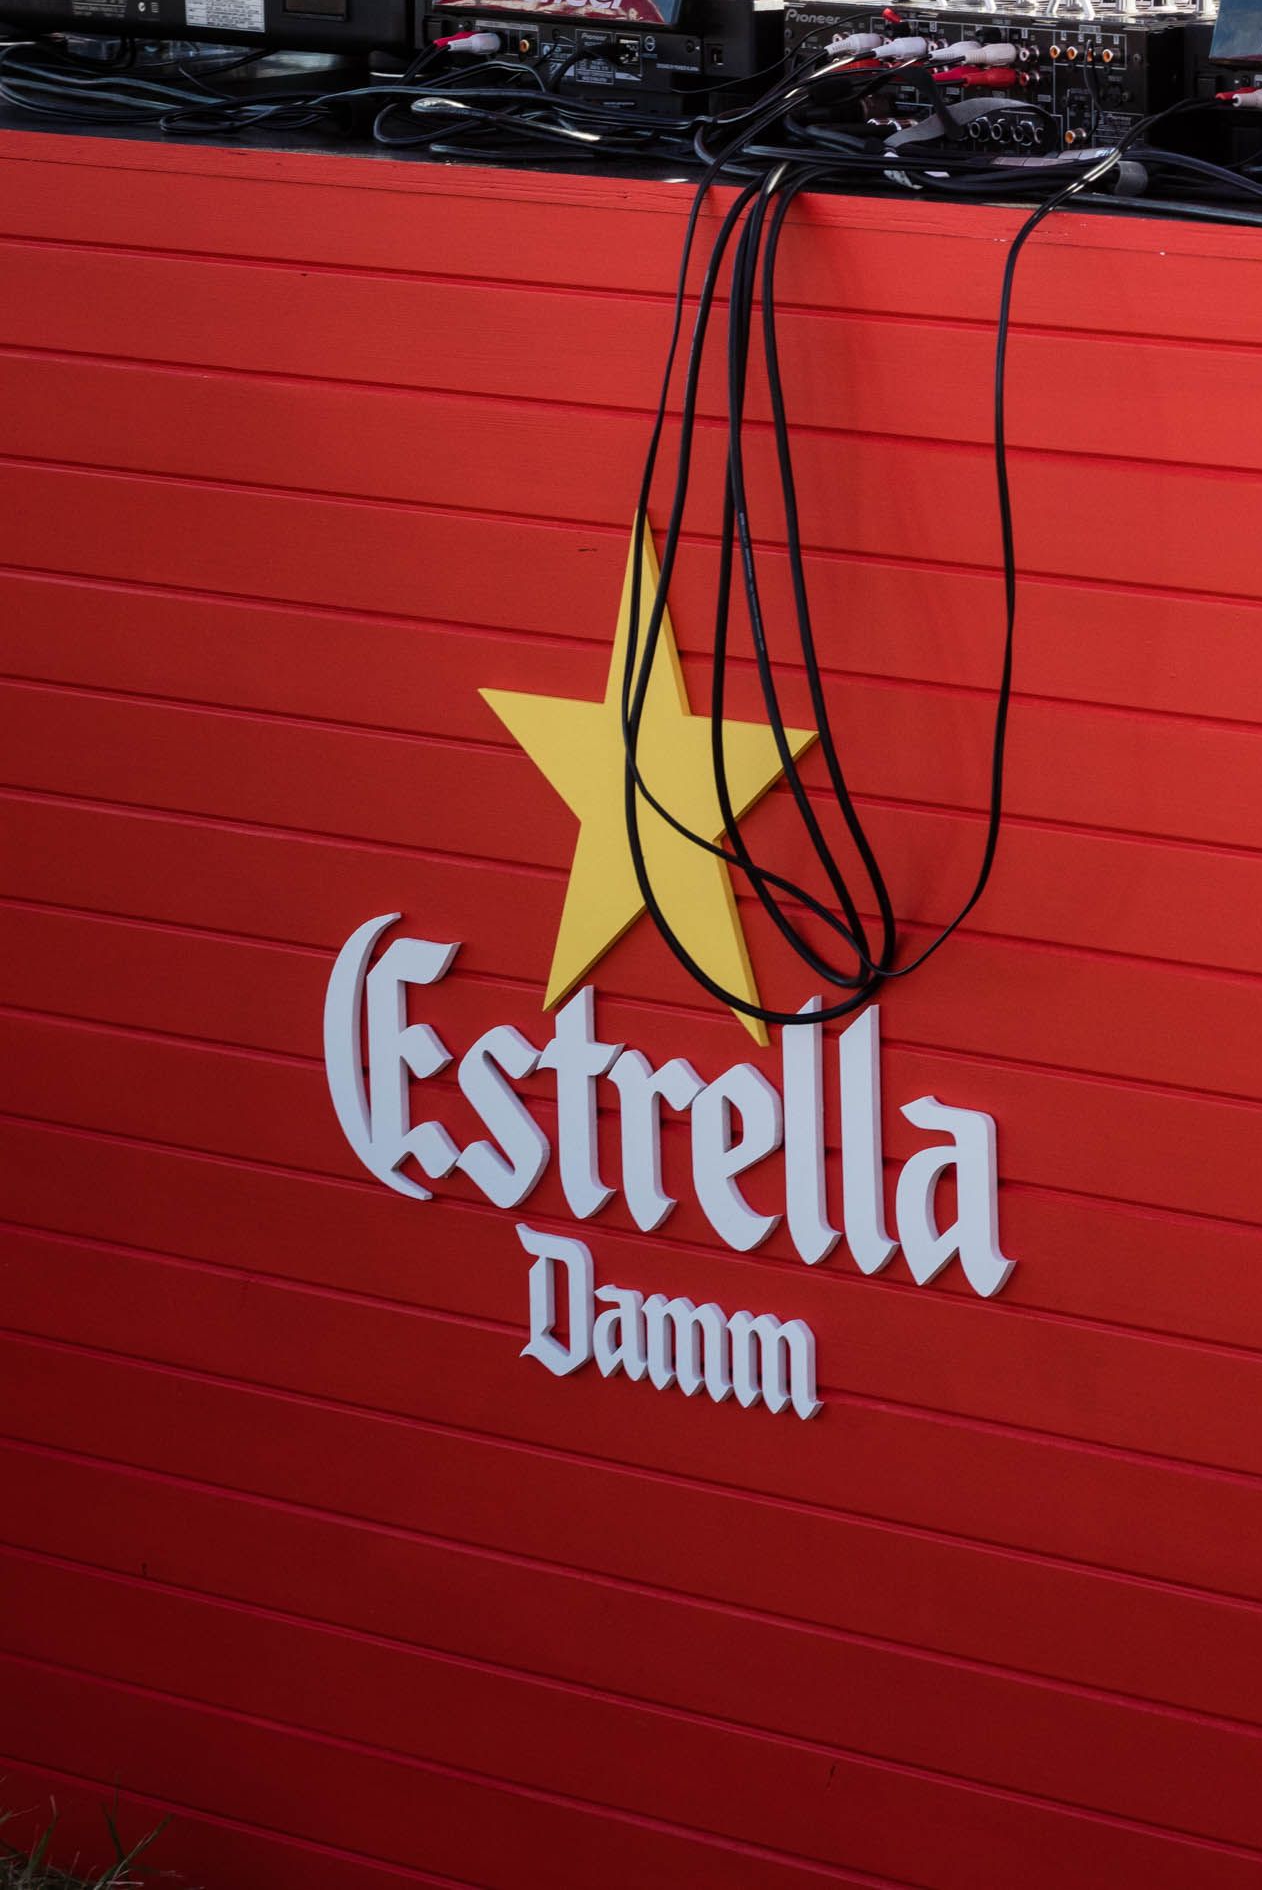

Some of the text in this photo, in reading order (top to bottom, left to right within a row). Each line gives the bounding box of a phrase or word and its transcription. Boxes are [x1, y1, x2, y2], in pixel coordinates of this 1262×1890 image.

[784, 8, 841, 25] Pioneer
[323, 912, 1017, 1298] Estrella
[516, 1223, 823, 1419] Damm
